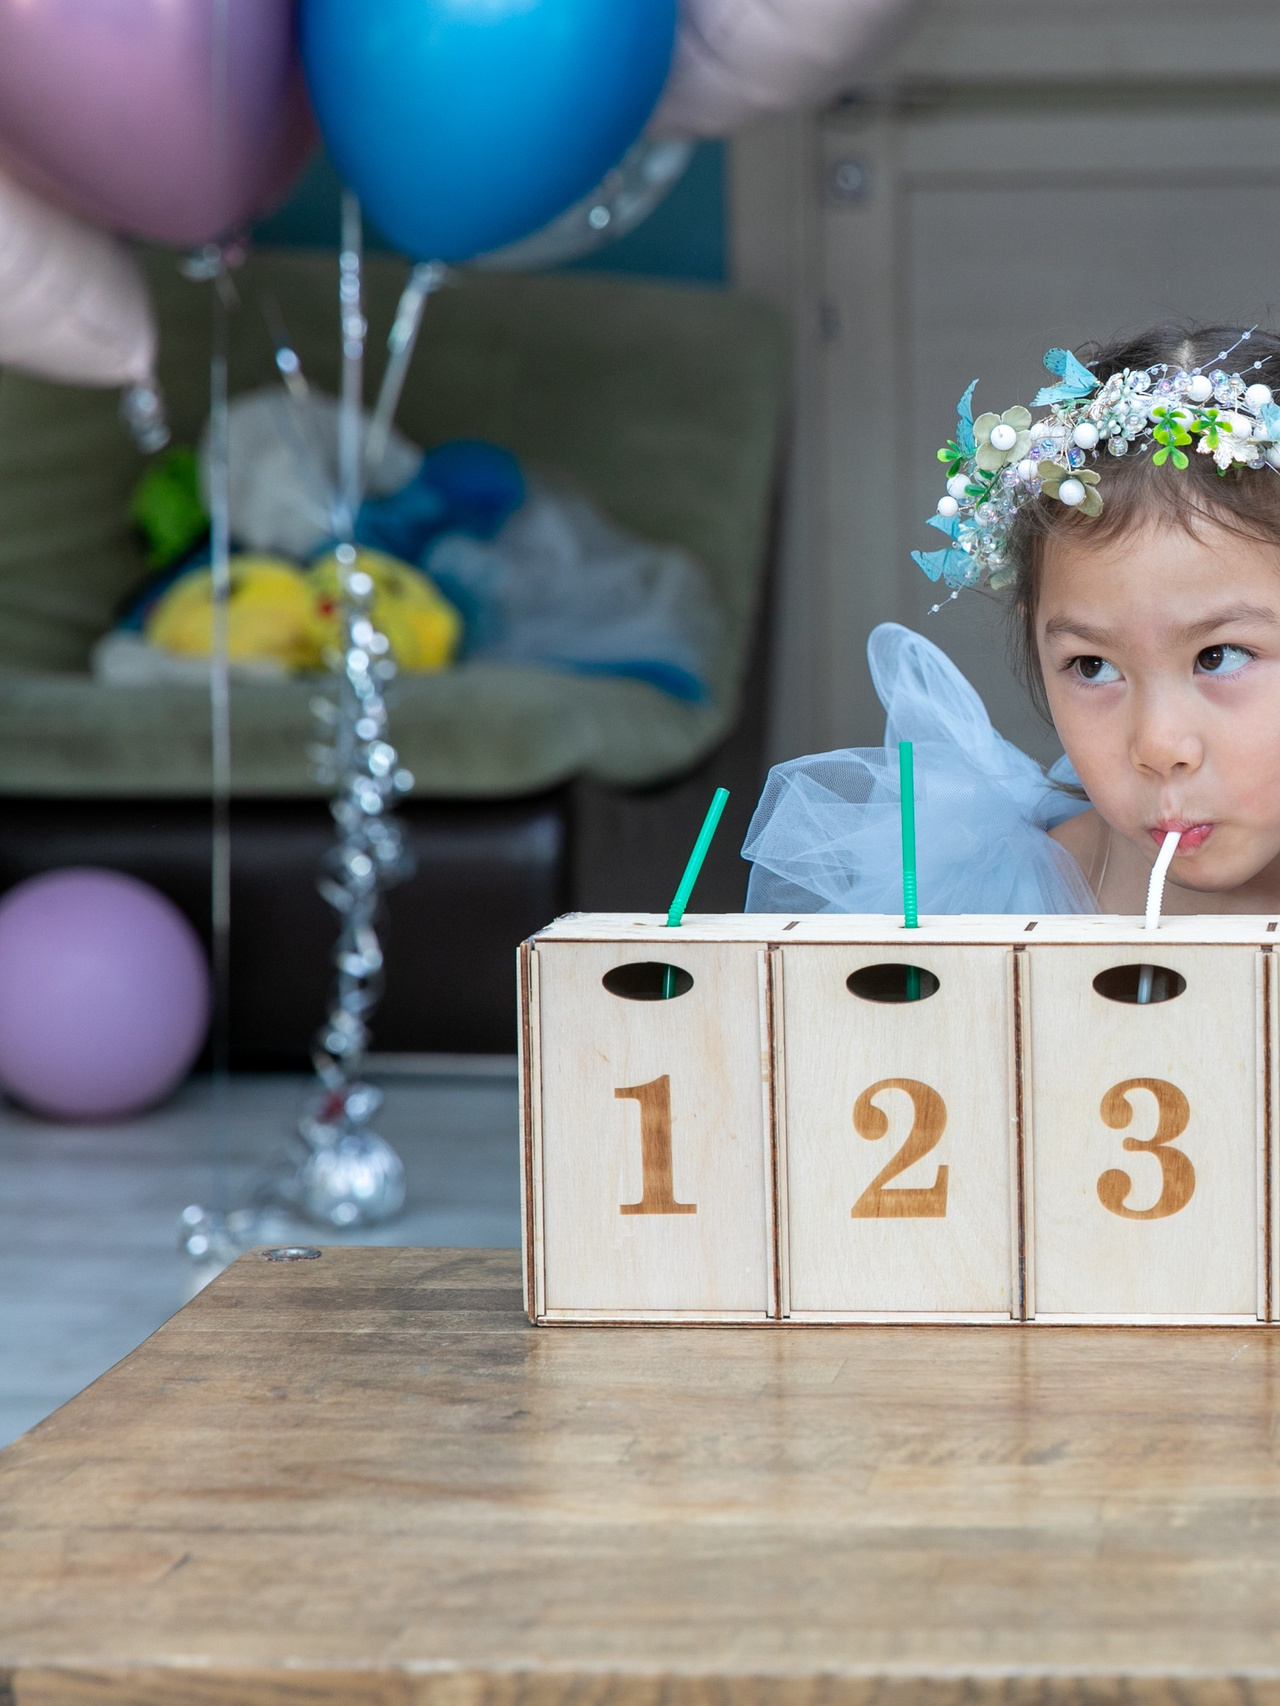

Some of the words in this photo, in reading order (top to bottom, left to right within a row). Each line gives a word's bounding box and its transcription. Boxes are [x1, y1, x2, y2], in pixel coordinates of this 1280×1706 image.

[615, 1074, 697, 1216] 1
[851, 1078, 949, 1219] 2
[1096, 1077, 1196, 1220] 3
